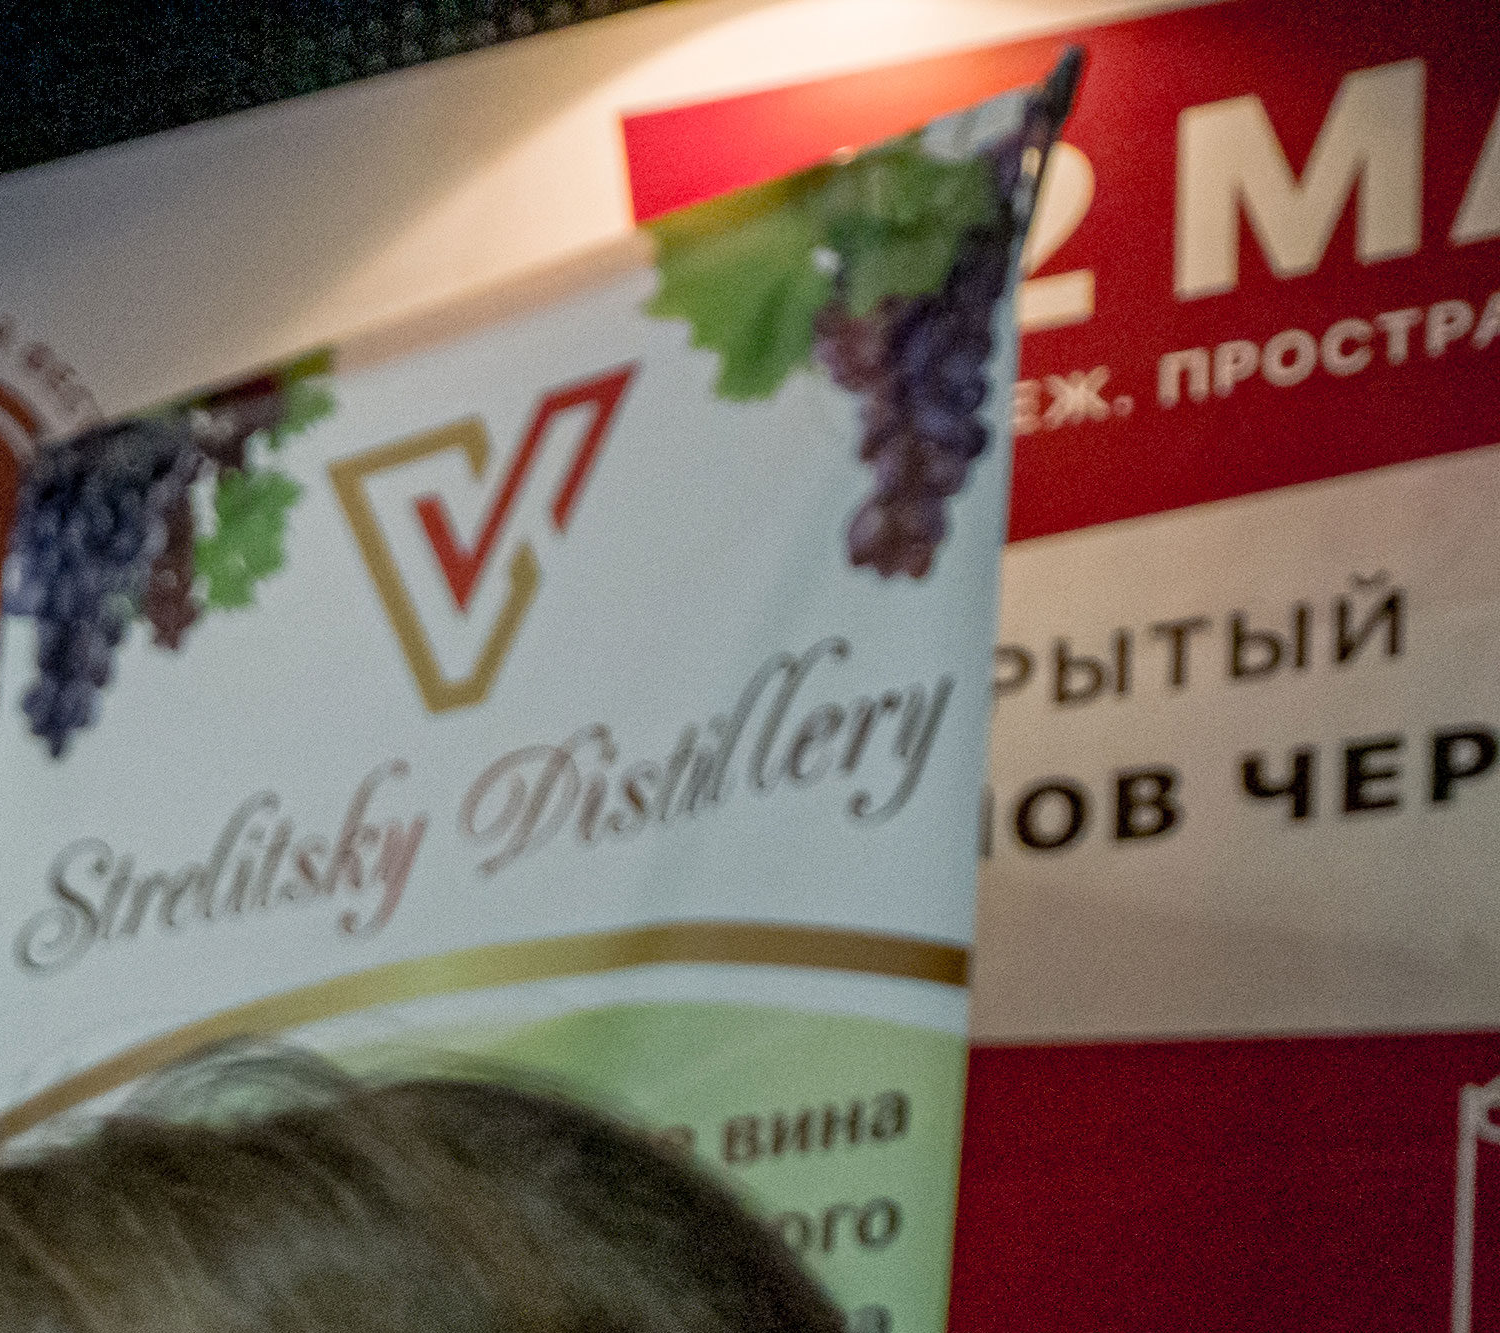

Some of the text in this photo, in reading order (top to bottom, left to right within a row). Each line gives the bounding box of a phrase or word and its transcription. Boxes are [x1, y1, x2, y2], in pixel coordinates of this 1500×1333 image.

[1173, 57, 1500, 303] М
[1012, 364, 1136, 437] ЕЖ.
[12, 634, 956, 977] Strelitsky Distillery
[723, 1088, 910, 1166] вина
